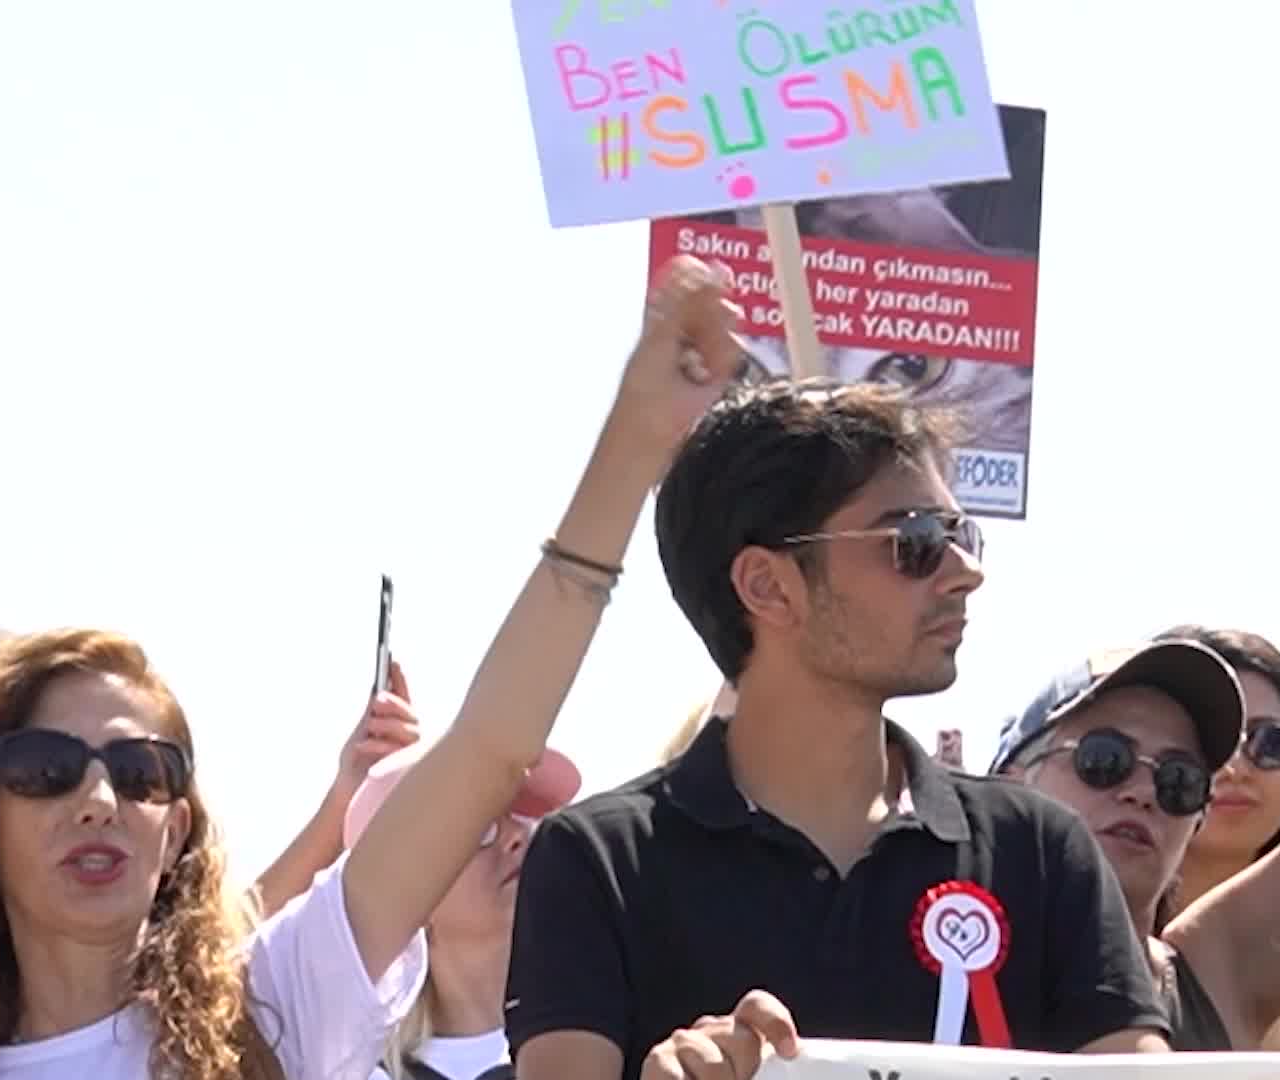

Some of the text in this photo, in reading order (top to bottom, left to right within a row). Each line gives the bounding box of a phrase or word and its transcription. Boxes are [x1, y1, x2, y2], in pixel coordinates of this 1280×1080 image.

[554, 42, 688, 112] BEN
[587, 46, 966, 182] #SUSMA
[677, 228, 1013, 292] Sakın andan çıkmasın...
[816, 278, 858, 305] her
[865, 285, 971, 317] yaradan
[860, 314, 1021, 353] YARADAN!!!
